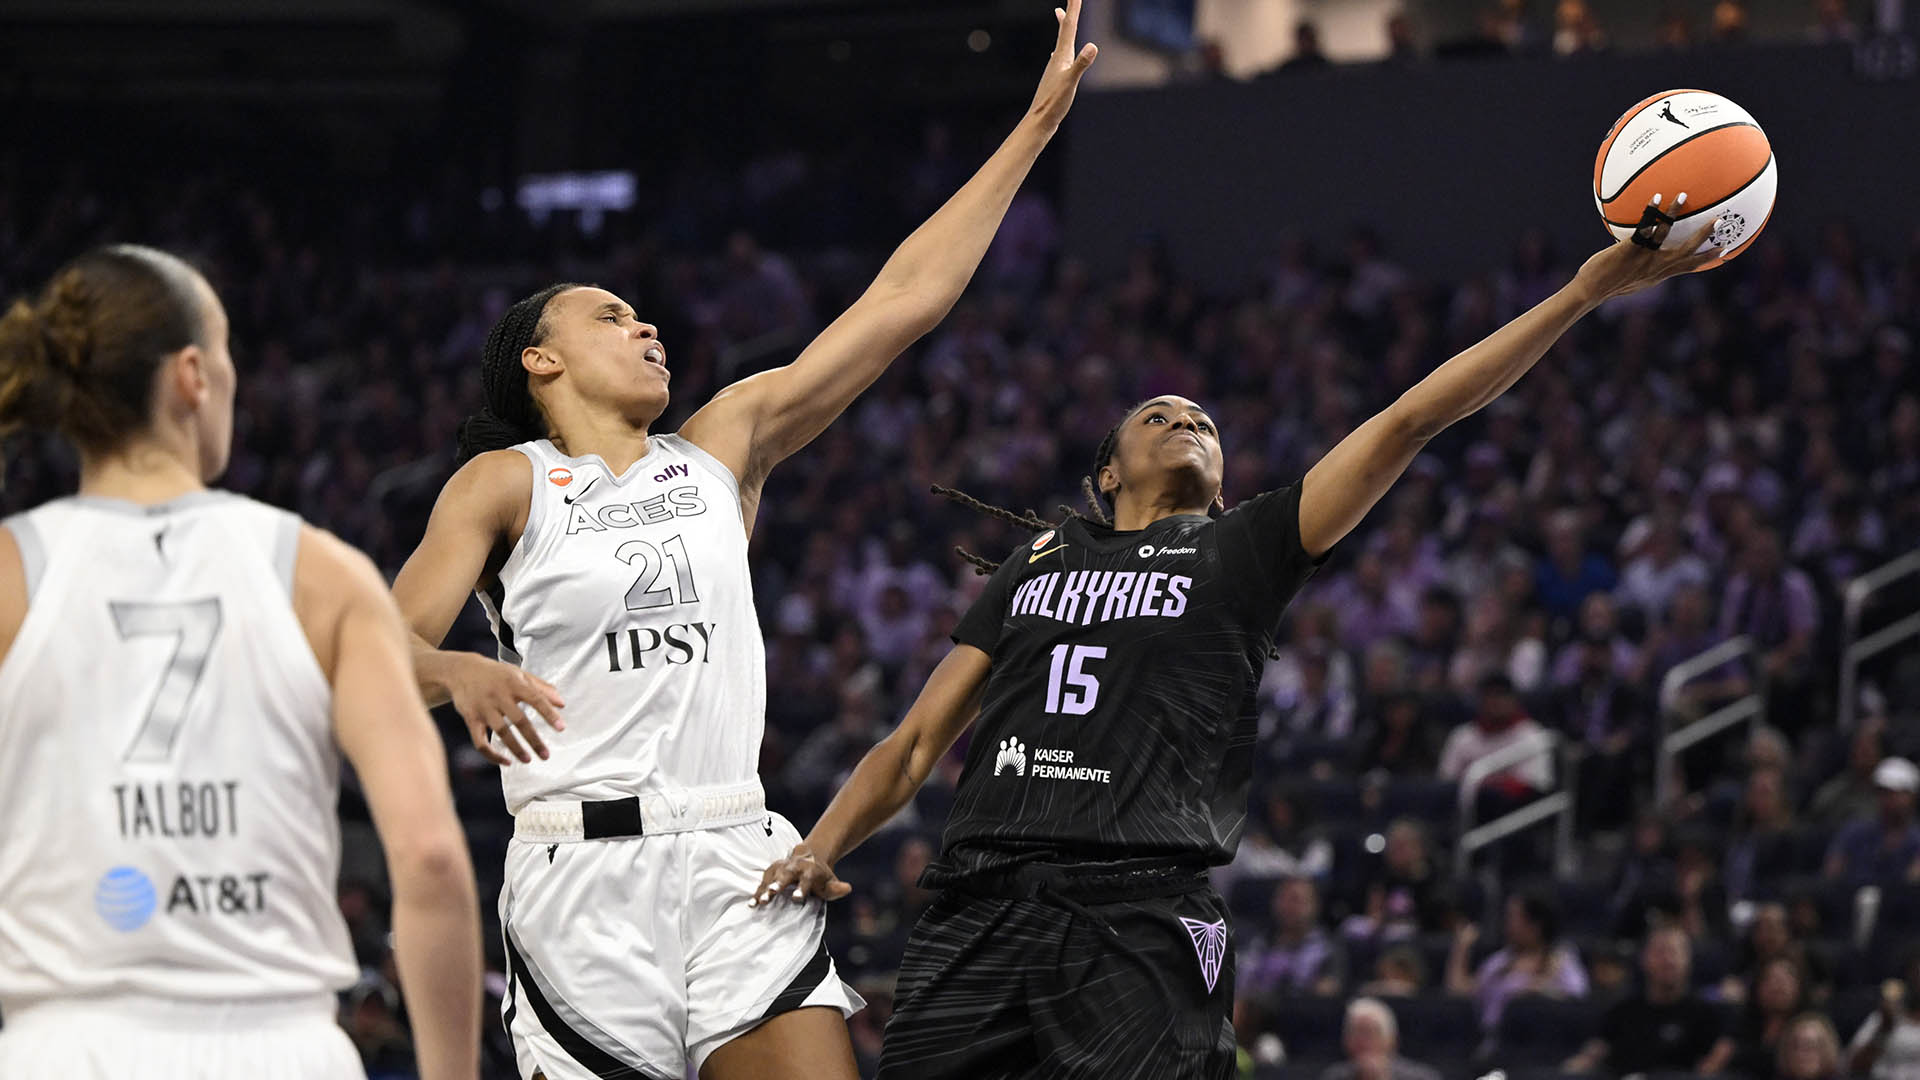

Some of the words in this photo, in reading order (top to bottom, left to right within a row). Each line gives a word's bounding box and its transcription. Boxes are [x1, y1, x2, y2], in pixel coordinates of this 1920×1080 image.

[653, 463, 688, 482] ally
[566, 486, 707, 535] ACES
[615, 534, 700, 611] 21
[1156, 546, 1197, 557] freedom
[1011, 570, 1193, 626] VALKYRIES
[605, 622, 716, 672] IPSY
[108, 597, 222, 763] 7
[1044, 644, 1107, 715] 15
[1031, 764, 1111, 783] PERMANENTE
[1034, 748, 1074, 763] KAISER
[112, 781, 239, 838] TALBOT
[166, 874, 271, 914] AT&T
